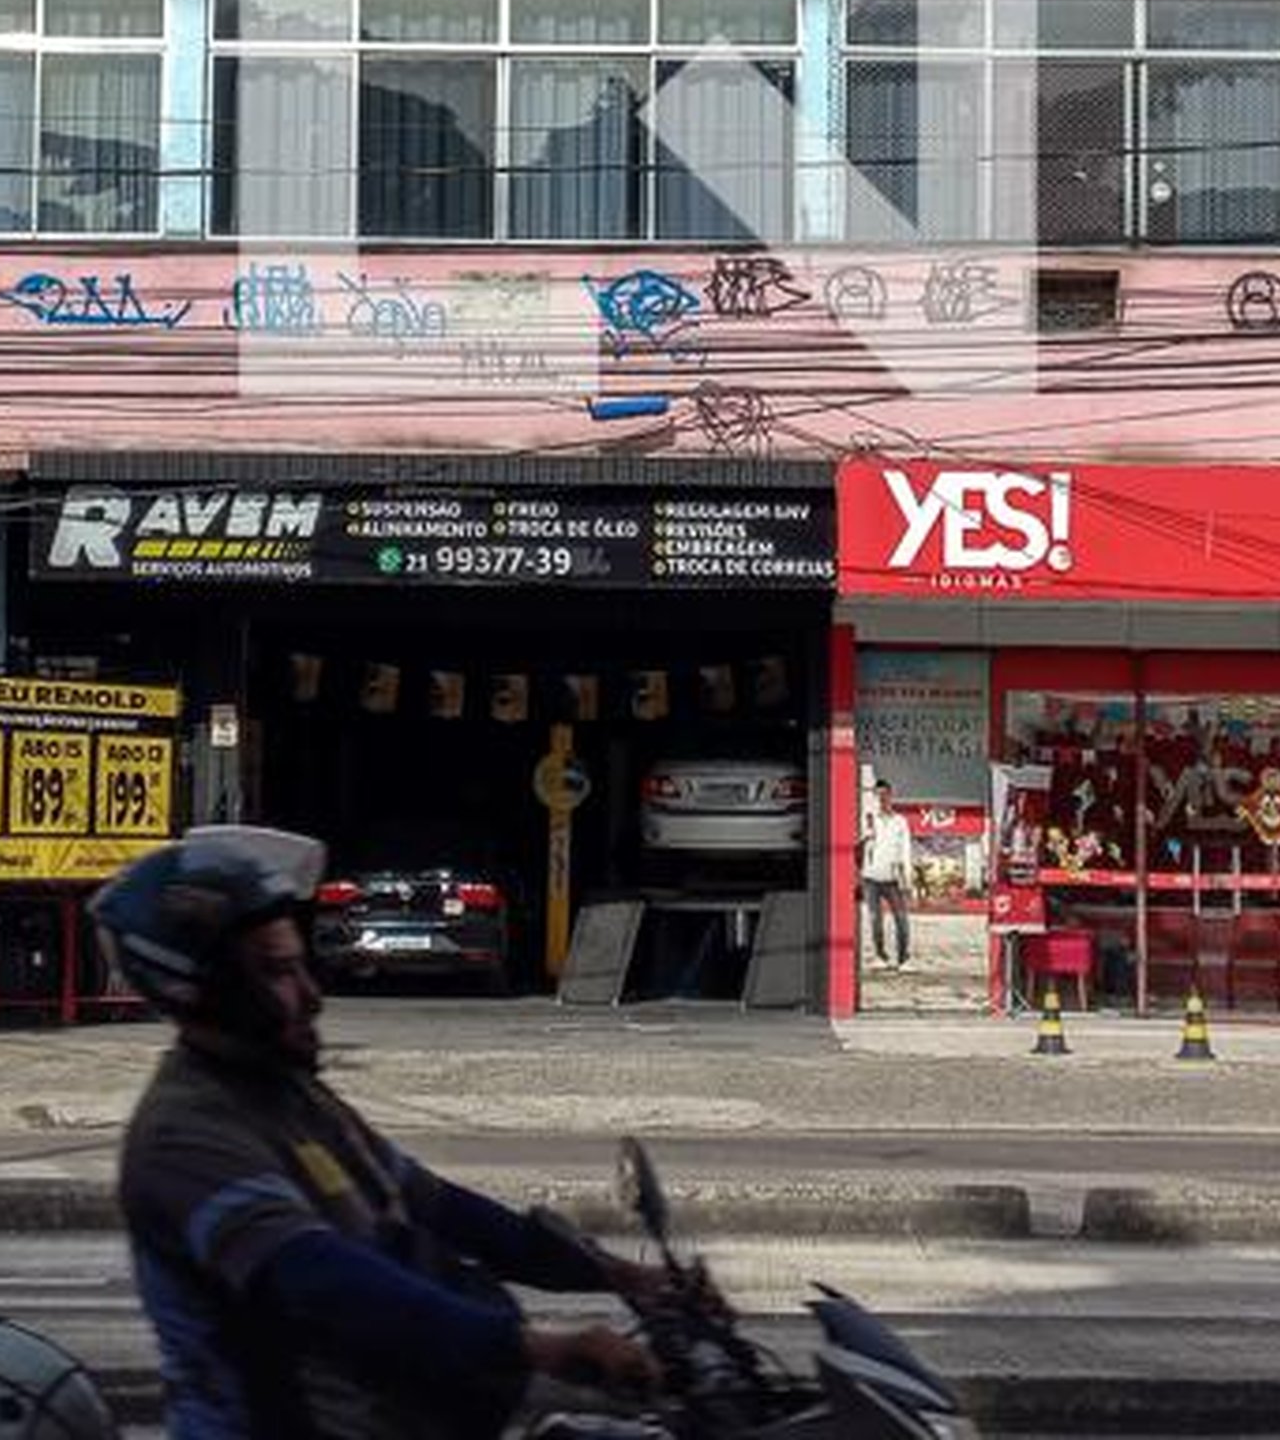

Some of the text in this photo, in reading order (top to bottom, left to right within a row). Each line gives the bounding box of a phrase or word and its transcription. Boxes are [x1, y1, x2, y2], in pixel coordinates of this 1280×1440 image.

[508, 520, 561, 537] TROCA
[568, 520, 590, 537] DE
[883, 471, 1072, 571] YES!
[665, 538, 774, 556] EMBREAGEM
[667, 558, 722, 575] TROCA
[725, 558, 746, 575] DE
[34, 685, 148, 709] REMOLD
[23, 768, 65, 828] 189
